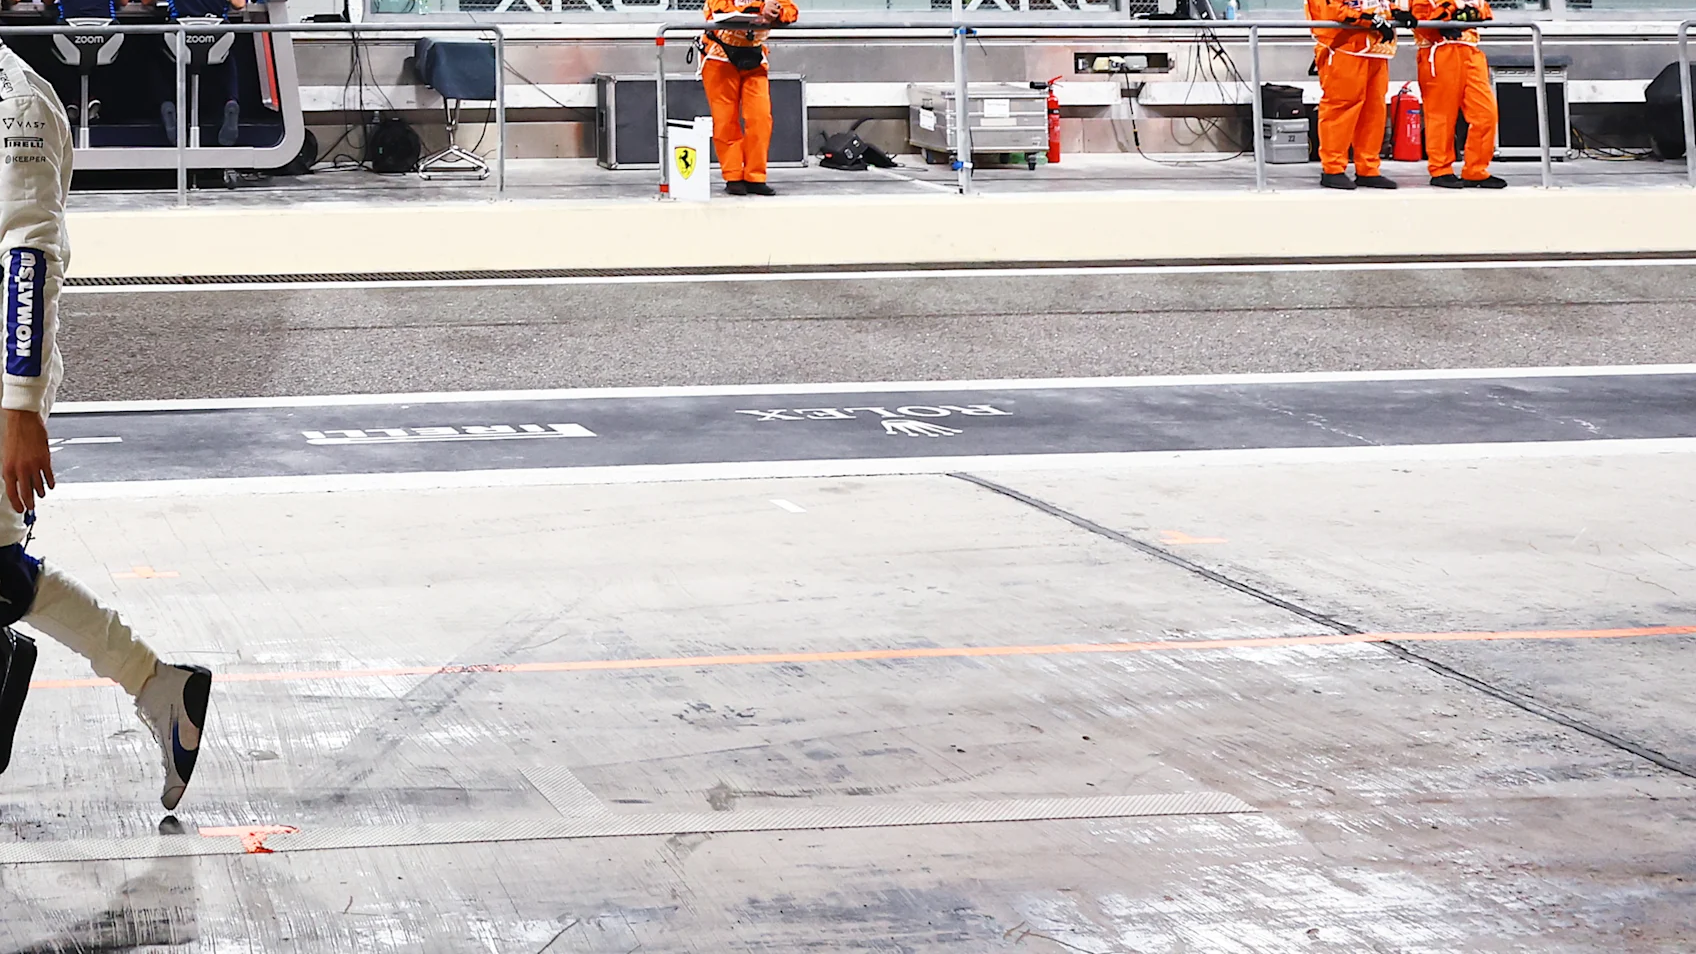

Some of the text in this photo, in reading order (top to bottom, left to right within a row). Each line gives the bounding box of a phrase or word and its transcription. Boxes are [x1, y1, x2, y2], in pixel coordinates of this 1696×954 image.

[74, 34, 105, 45] zoom
[186, 34, 215, 44] zoom
[16, 121, 46, 130] VAST
[4, 136, 44, 148] PIRELLI
[12, 155, 47, 163] KEEPER
[14, 251, 37, 358] KOMATSU
[734, 404, 1014, 421] ROLEX
[302, 422, 598, 446] PIRELLI
